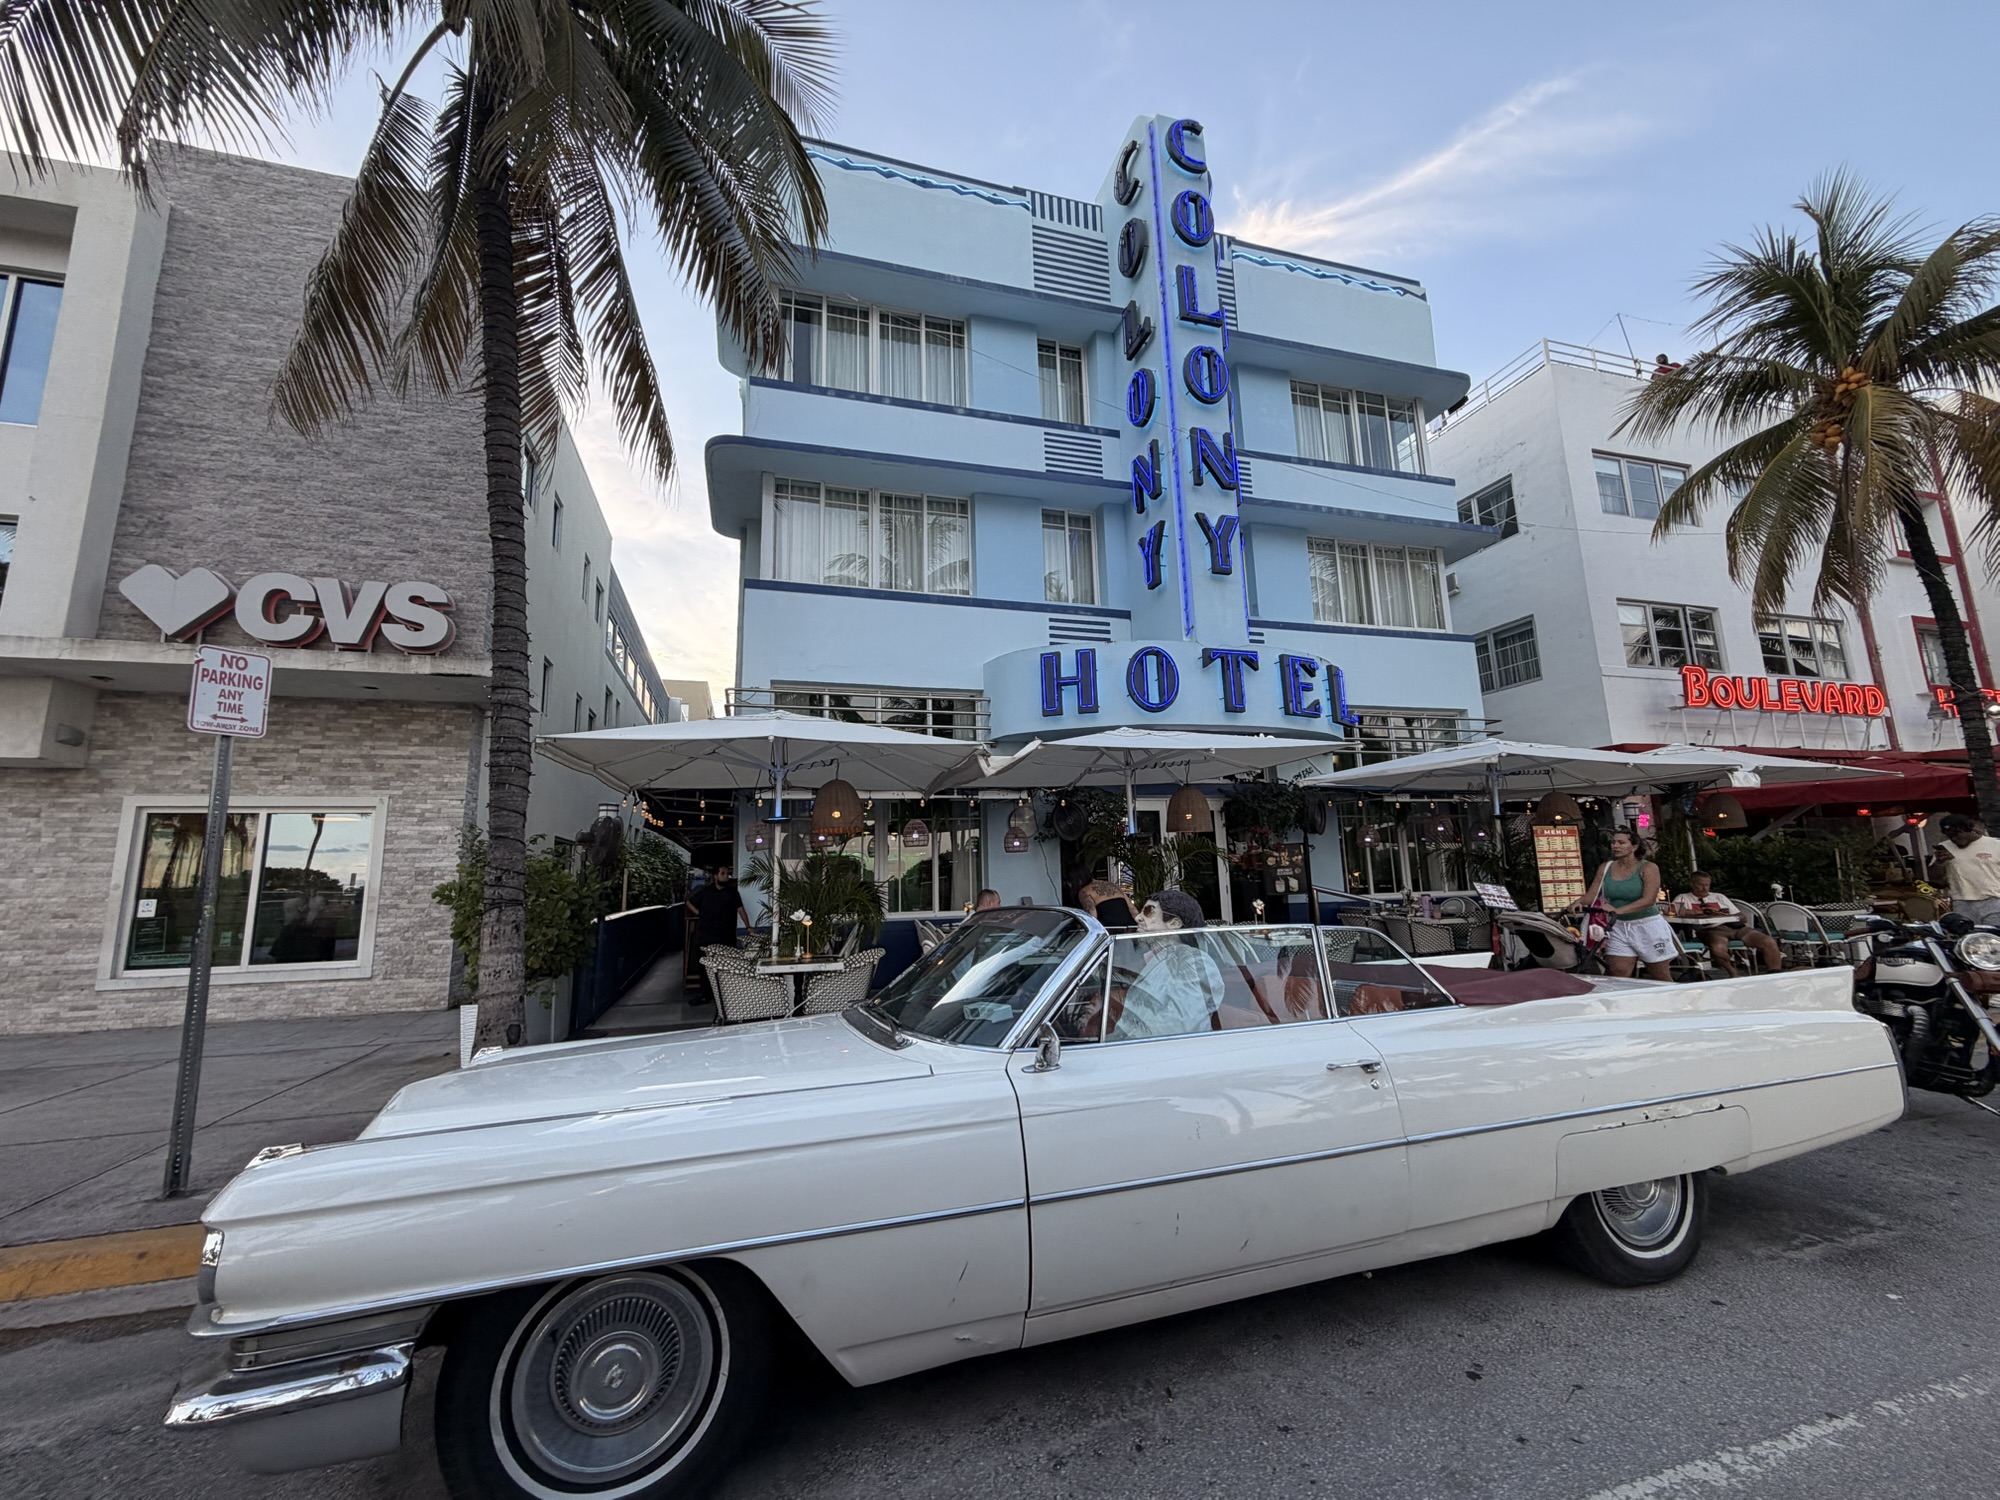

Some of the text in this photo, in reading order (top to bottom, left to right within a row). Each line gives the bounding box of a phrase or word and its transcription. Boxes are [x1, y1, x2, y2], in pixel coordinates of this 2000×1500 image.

[1114, 140, 1166, 591] COLONY
[1165, 119, 1240, 576] COLONY
[235, 572, 455, 652] CVS
[200, 667, 264, 691] PARKING
[220, 653, 249, 671] NO
[217, 688, 245, 702] ANY
[1040, 646, 1359, 726] HOTEL
[1681, 664, 1887, 717] BOULEVARD
[216, 701, 244, 715] TIME
[238, 724, 260, 733] ZONE
